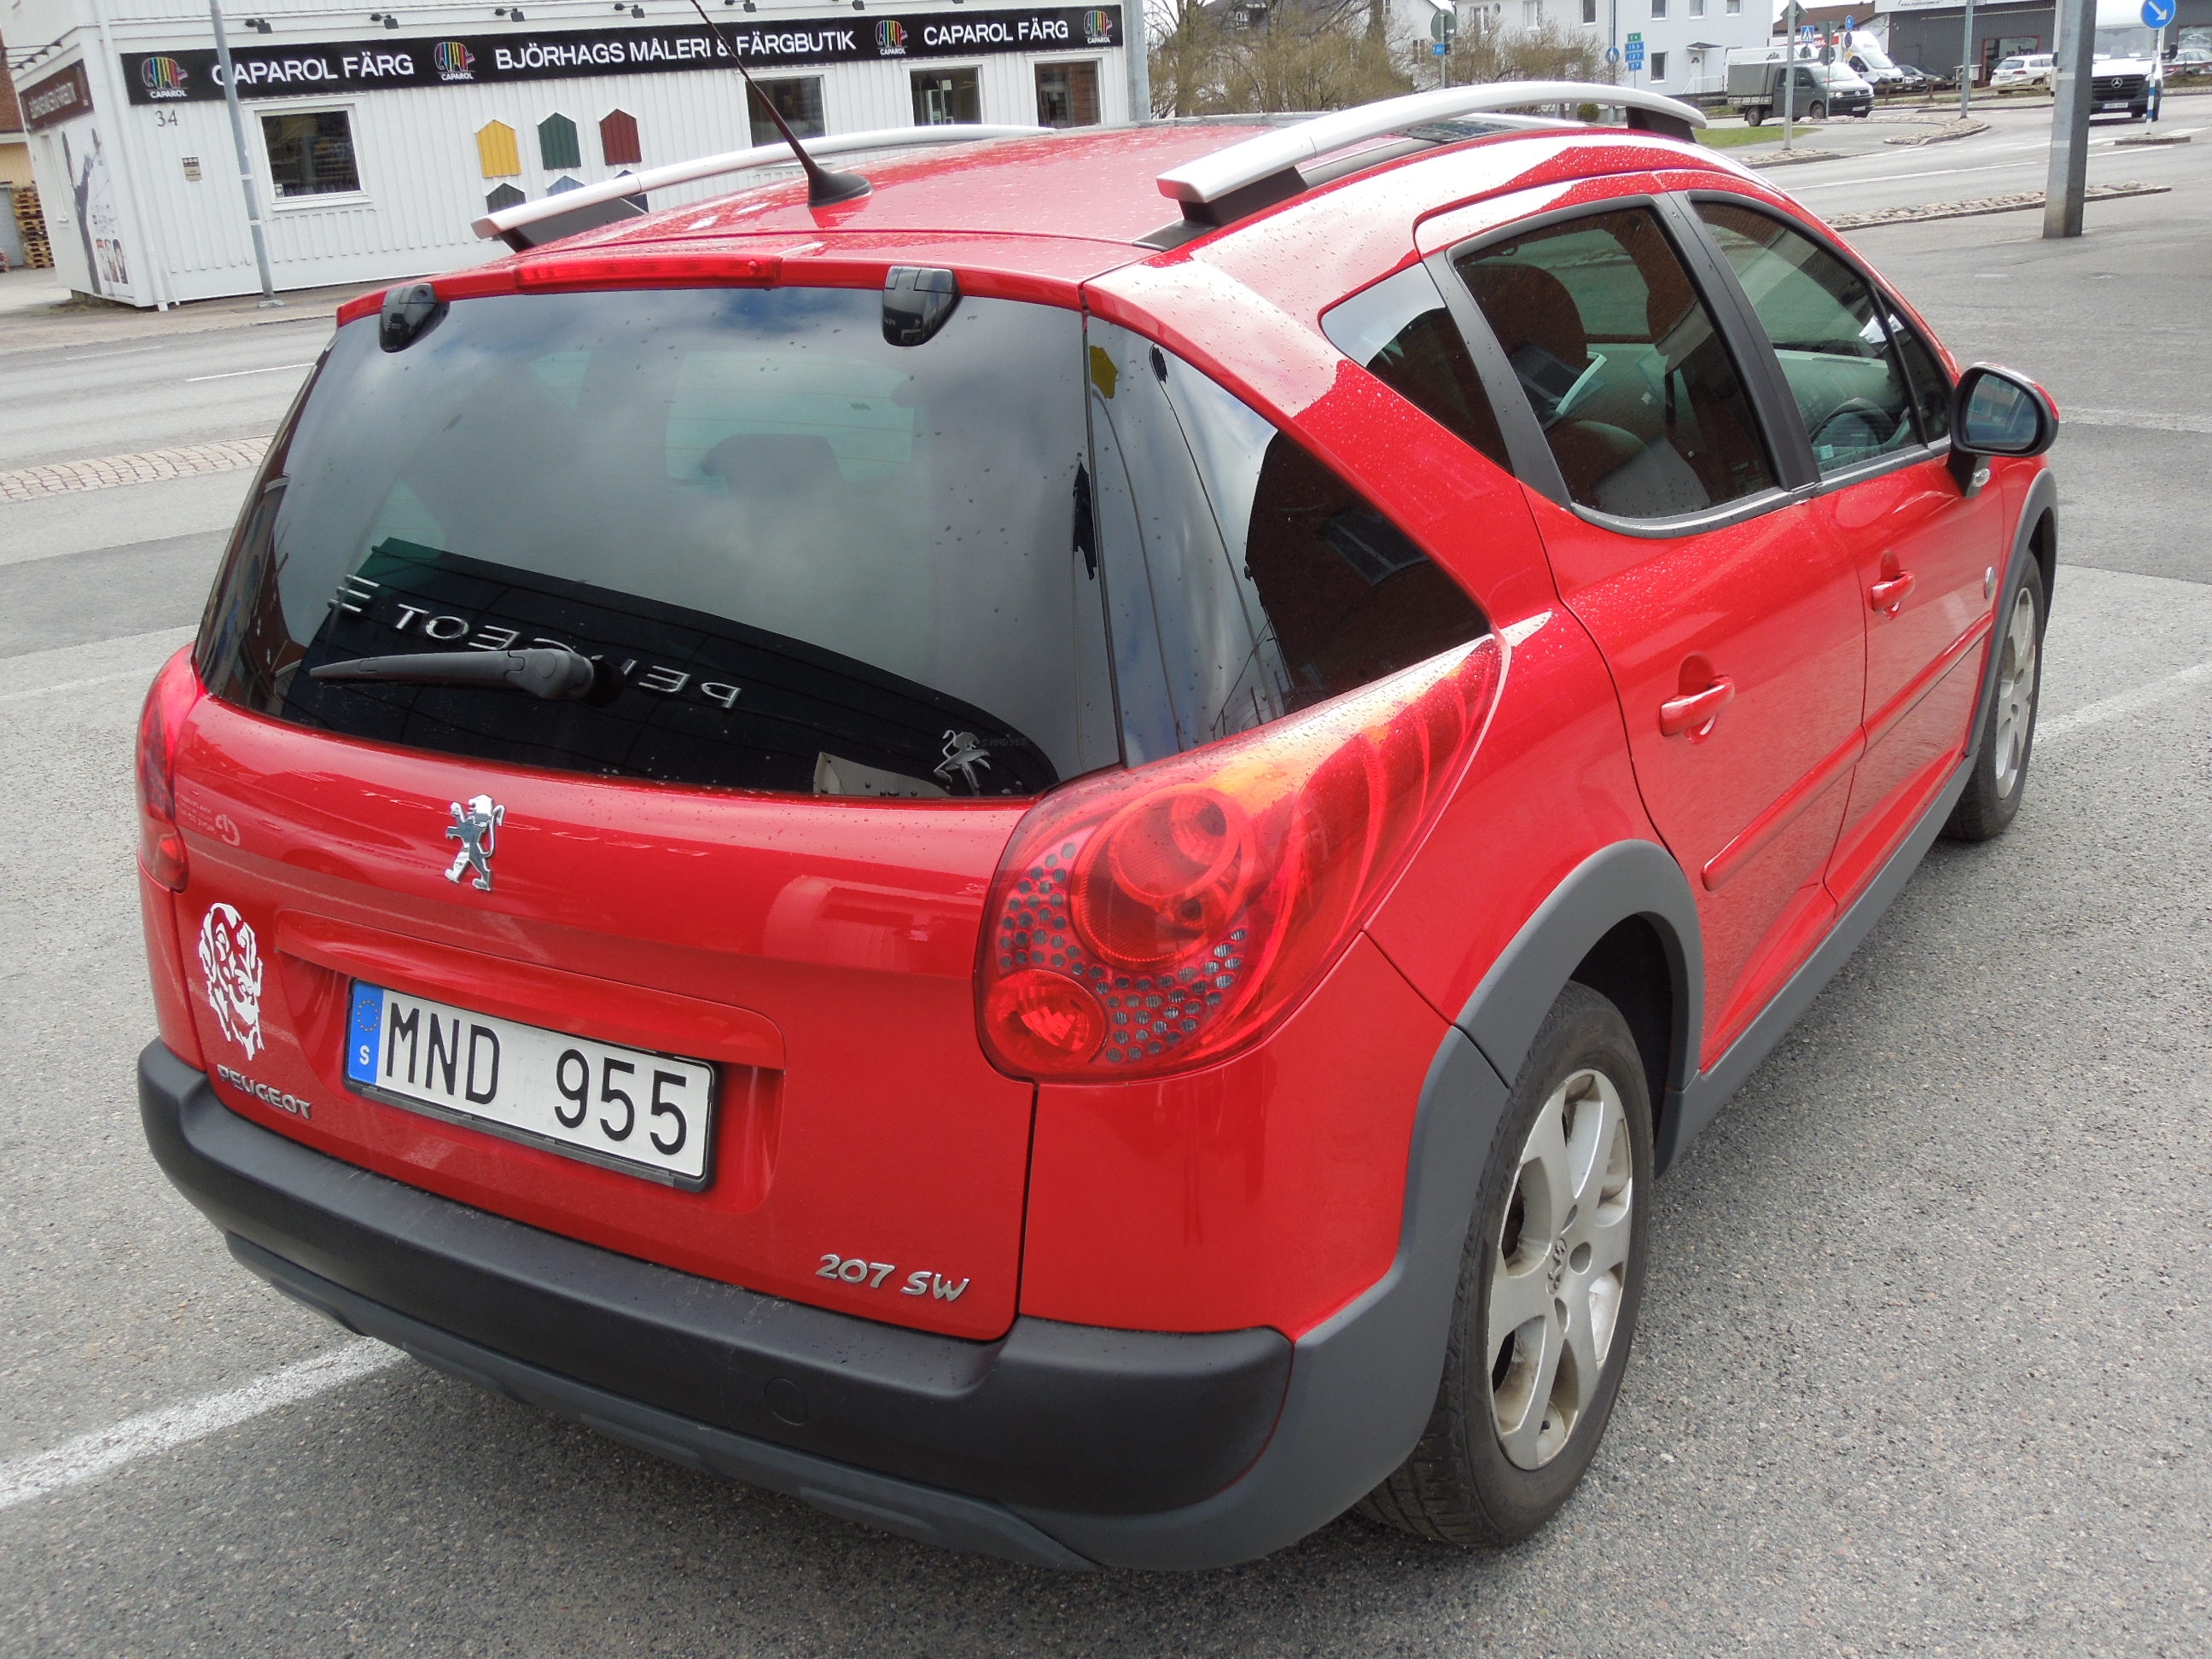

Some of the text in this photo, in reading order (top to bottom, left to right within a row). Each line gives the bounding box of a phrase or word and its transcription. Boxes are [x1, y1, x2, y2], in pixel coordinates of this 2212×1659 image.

[923, 17, 1069, 46] CAPAROL FÄRG
[495, 31, 857, 70] BJÖRHAGS MÅLERI & FÄRGBUTIK
[211, 51, 415, 86] CAPAROL FÄRG
[440, 72, 474, 81] CAPAROL
[150, 90, 187, 98] CAPAROL
[155, 109, 178, 127] 34
[358, 1045, 370, 1066] S
[217, 1063, 311, 1120] PEUGEOT
[386, 1003, 688, 1155] MND 955
[815, 1254, 970, 1302] 207 SW
